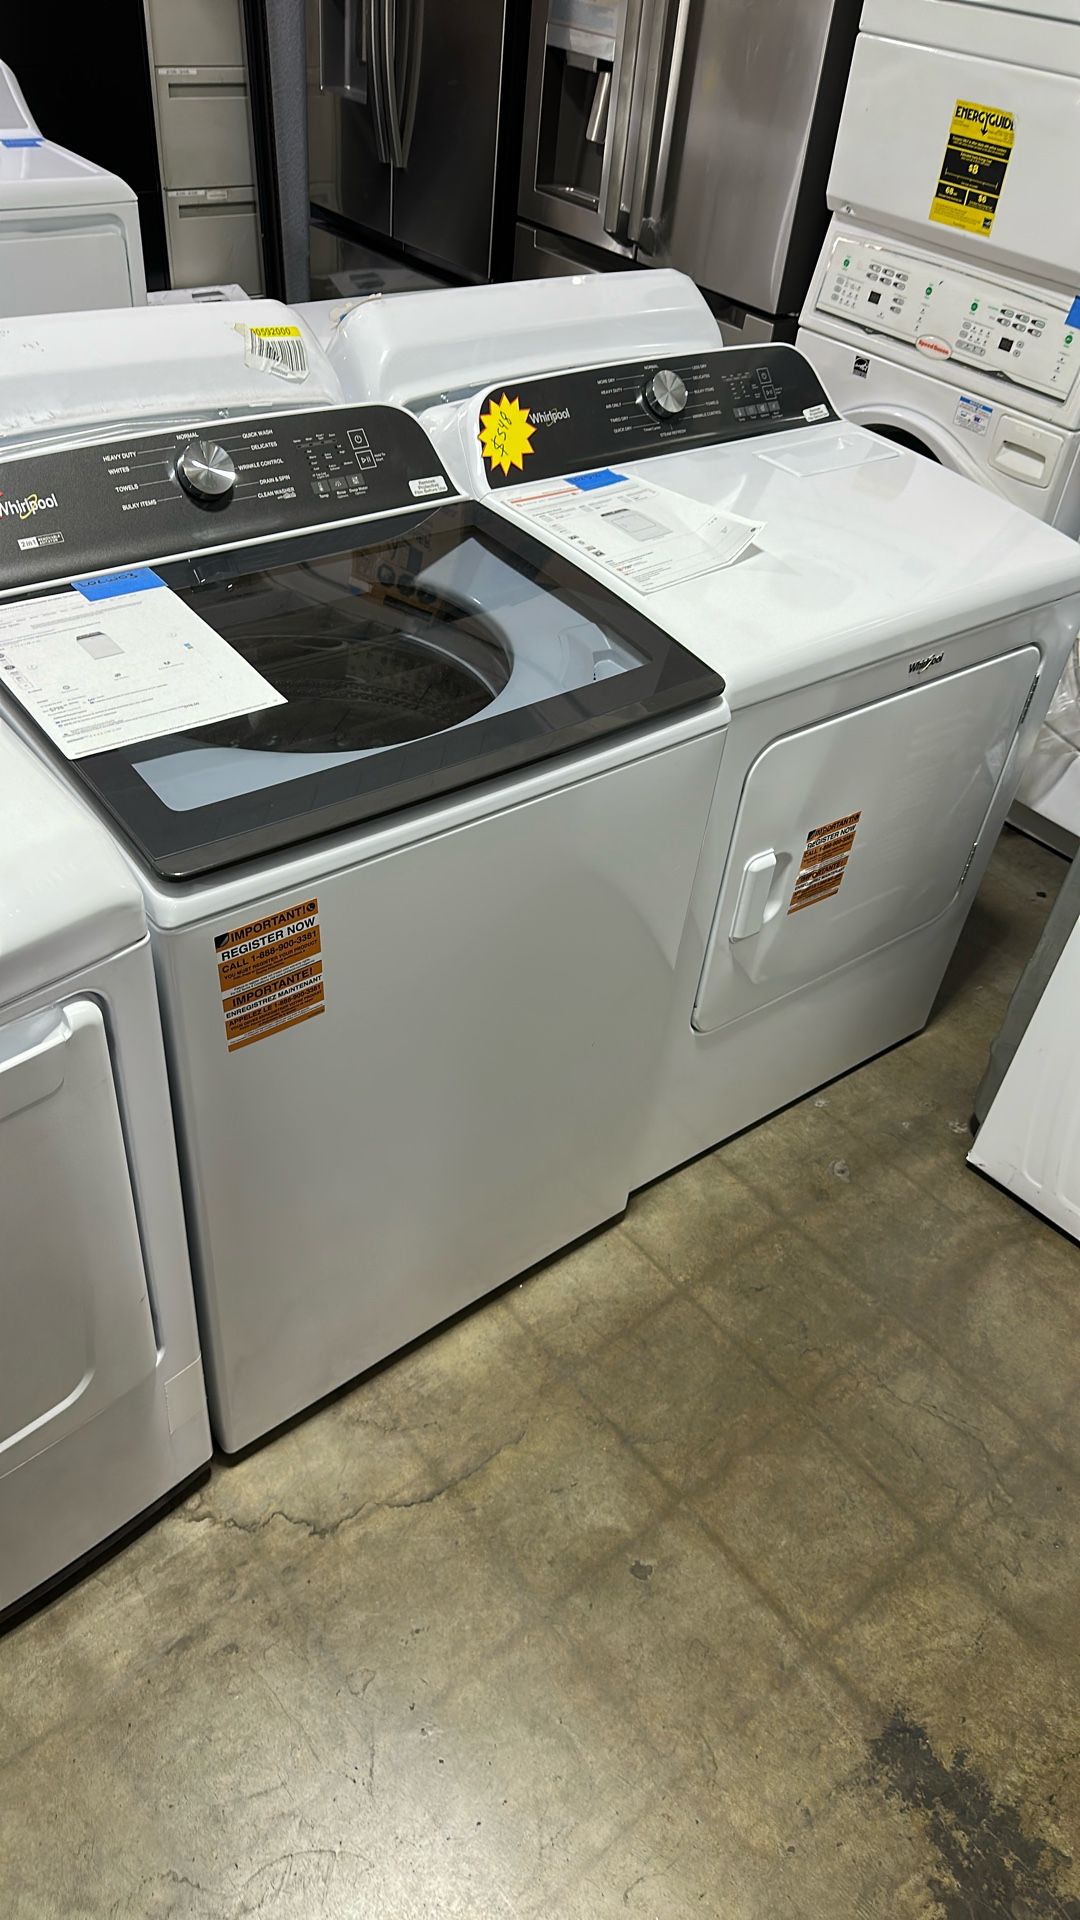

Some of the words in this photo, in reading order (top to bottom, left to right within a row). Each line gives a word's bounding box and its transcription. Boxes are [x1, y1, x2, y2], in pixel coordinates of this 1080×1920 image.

[529, 408, 571, 425] Whirlpool
[176, 431, 200, 441] NORMAL
[242, 431, 258, 439] QUICK
[257, 428, 274, 437] WASH
[250, 440, 278, 451] DELICATES
[102, 453, 121, 462] HEAVY
[121, 451, 137, 460] DUTY
[108, 465, 130, 475] WHITES
[238, 461, 260, 471] WRINKLE
[260, 457, 285, 467] CONTROL
[259, 478, 275, 486] DRAIN
[278, 474, 291, 482] SPIN
[115, 483, 139, 493] TOWELS
[257, 490, 274, 499] CLEAN
[274, 486, 296, 495] WASHER
[121, 501, 140, 511] BULKY
[139, 498, 157, 508] ITEMS
[807, 832, 840, 850] REGISTER
[839, 824, 856, 837] NOW
[231, 905, 306, 943] IMPORTANT!
[221, 930, 284, 962] REGISTER
[287, 916, 316, 936] NOW
[221, 957, 249, 974] CALL
[232, 967, 314, 1008] IMPORTANTE!
[226, 994, 277, 1019] ENREGISTREZ
[277, 974, 323, 998] MAINTENANT
